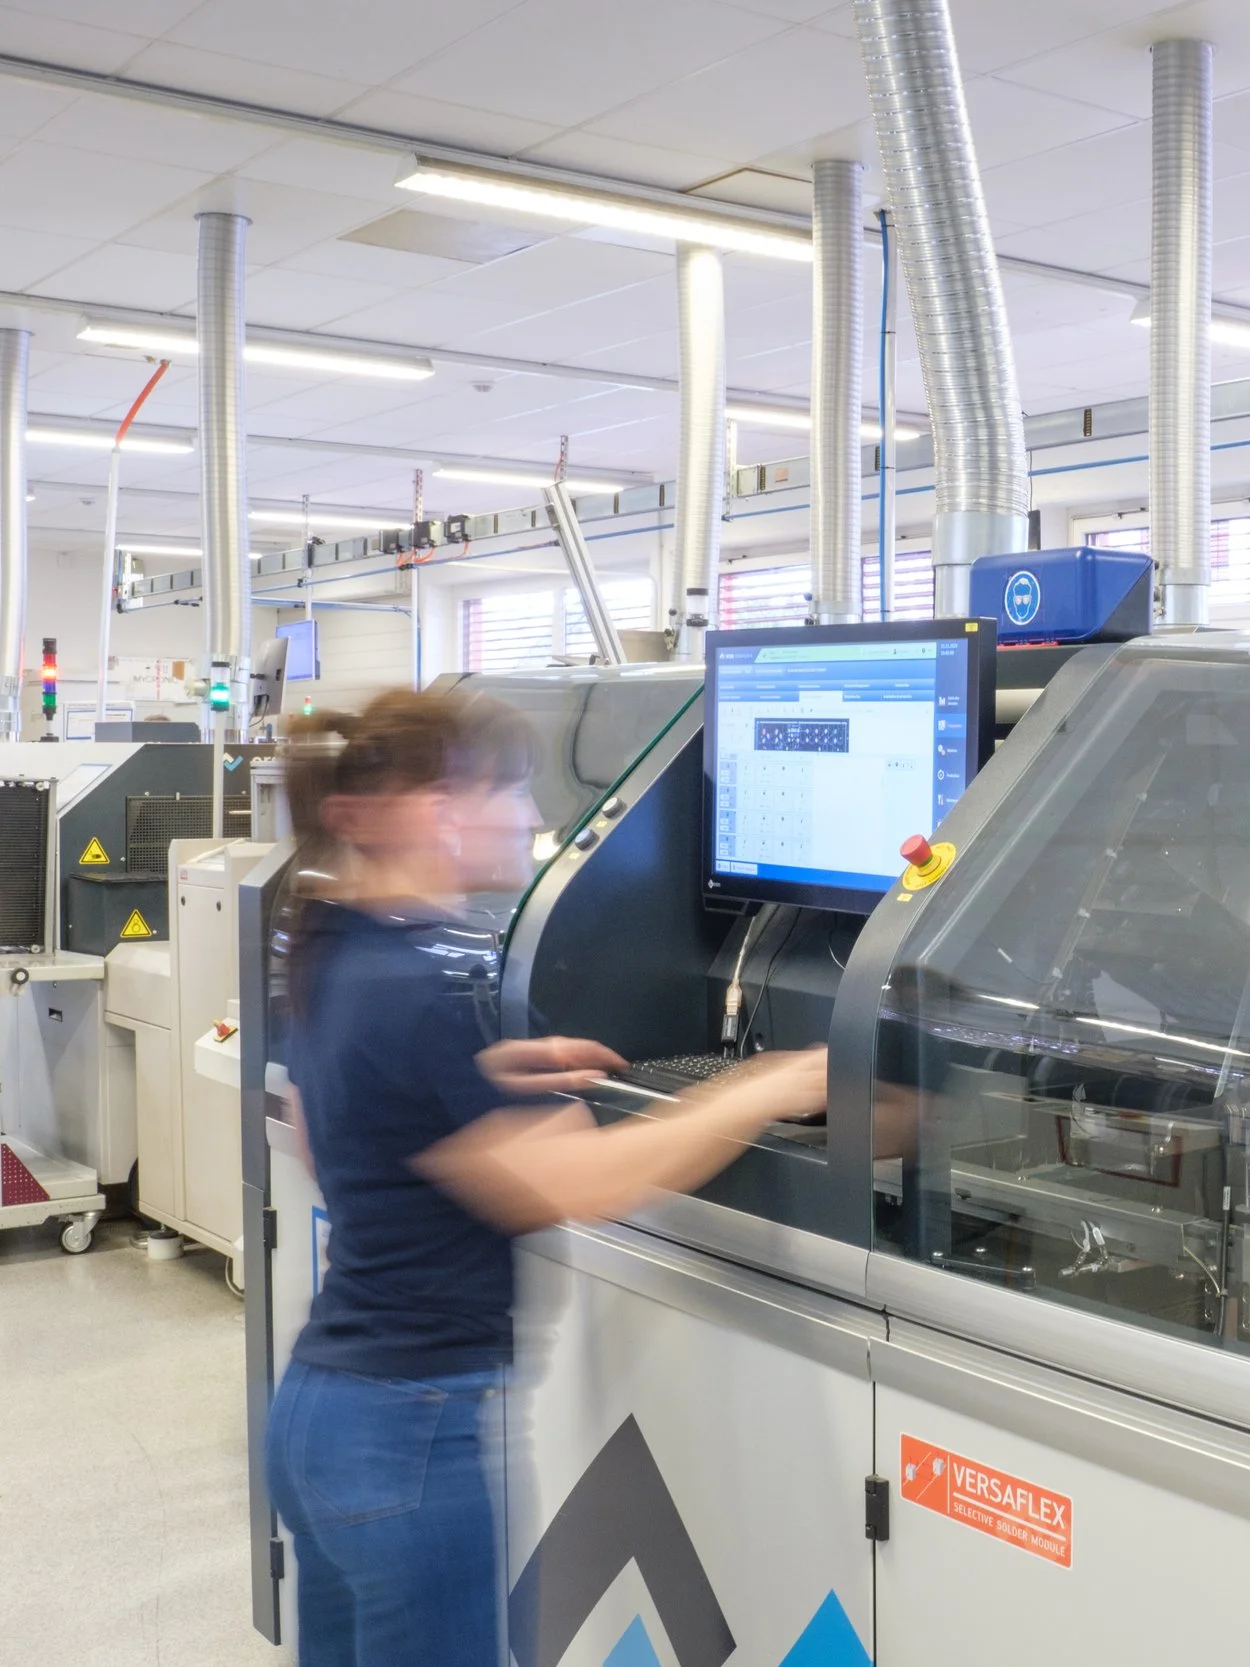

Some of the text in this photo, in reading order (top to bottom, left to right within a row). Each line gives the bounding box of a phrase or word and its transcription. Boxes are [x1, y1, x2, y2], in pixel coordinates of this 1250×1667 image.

[953, 1462, 1066, 1529] VERSAFLEX
[953, 1502, 1066, 1557] SELECTIVE SOLDER MODULE
